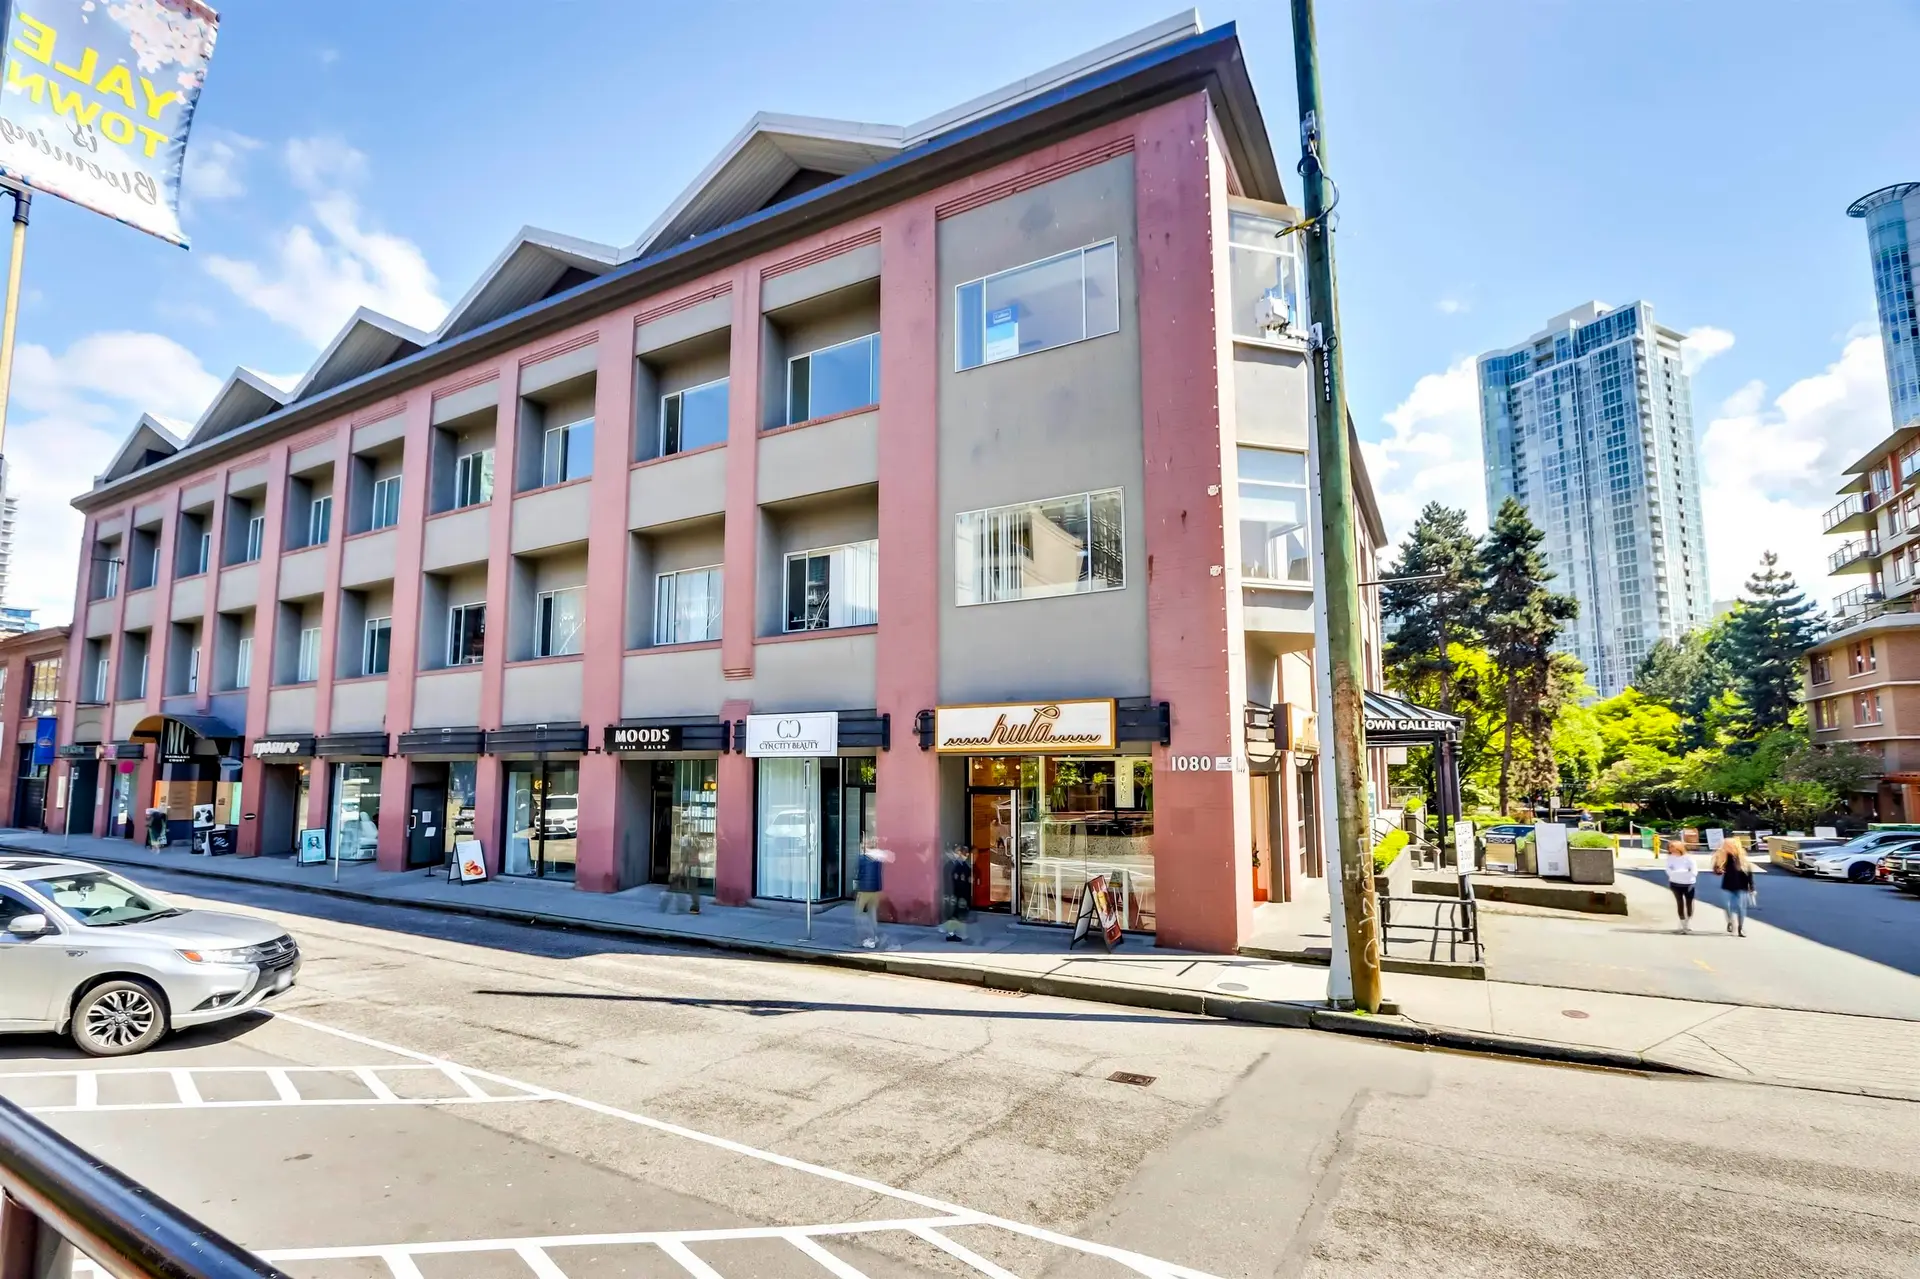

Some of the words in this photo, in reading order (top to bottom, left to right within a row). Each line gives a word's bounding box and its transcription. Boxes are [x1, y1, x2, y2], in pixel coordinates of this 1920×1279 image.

[1364, 720, 1396, 730] OWN
[1398, 719, 1453, 731] GALLERIA
[165, 721, 190, 755] MC
[614, 728, 670, 743] MOODS
[791, 741, 819, 750] BEAUTY
[1171, 755, 1212, 771] 1080
